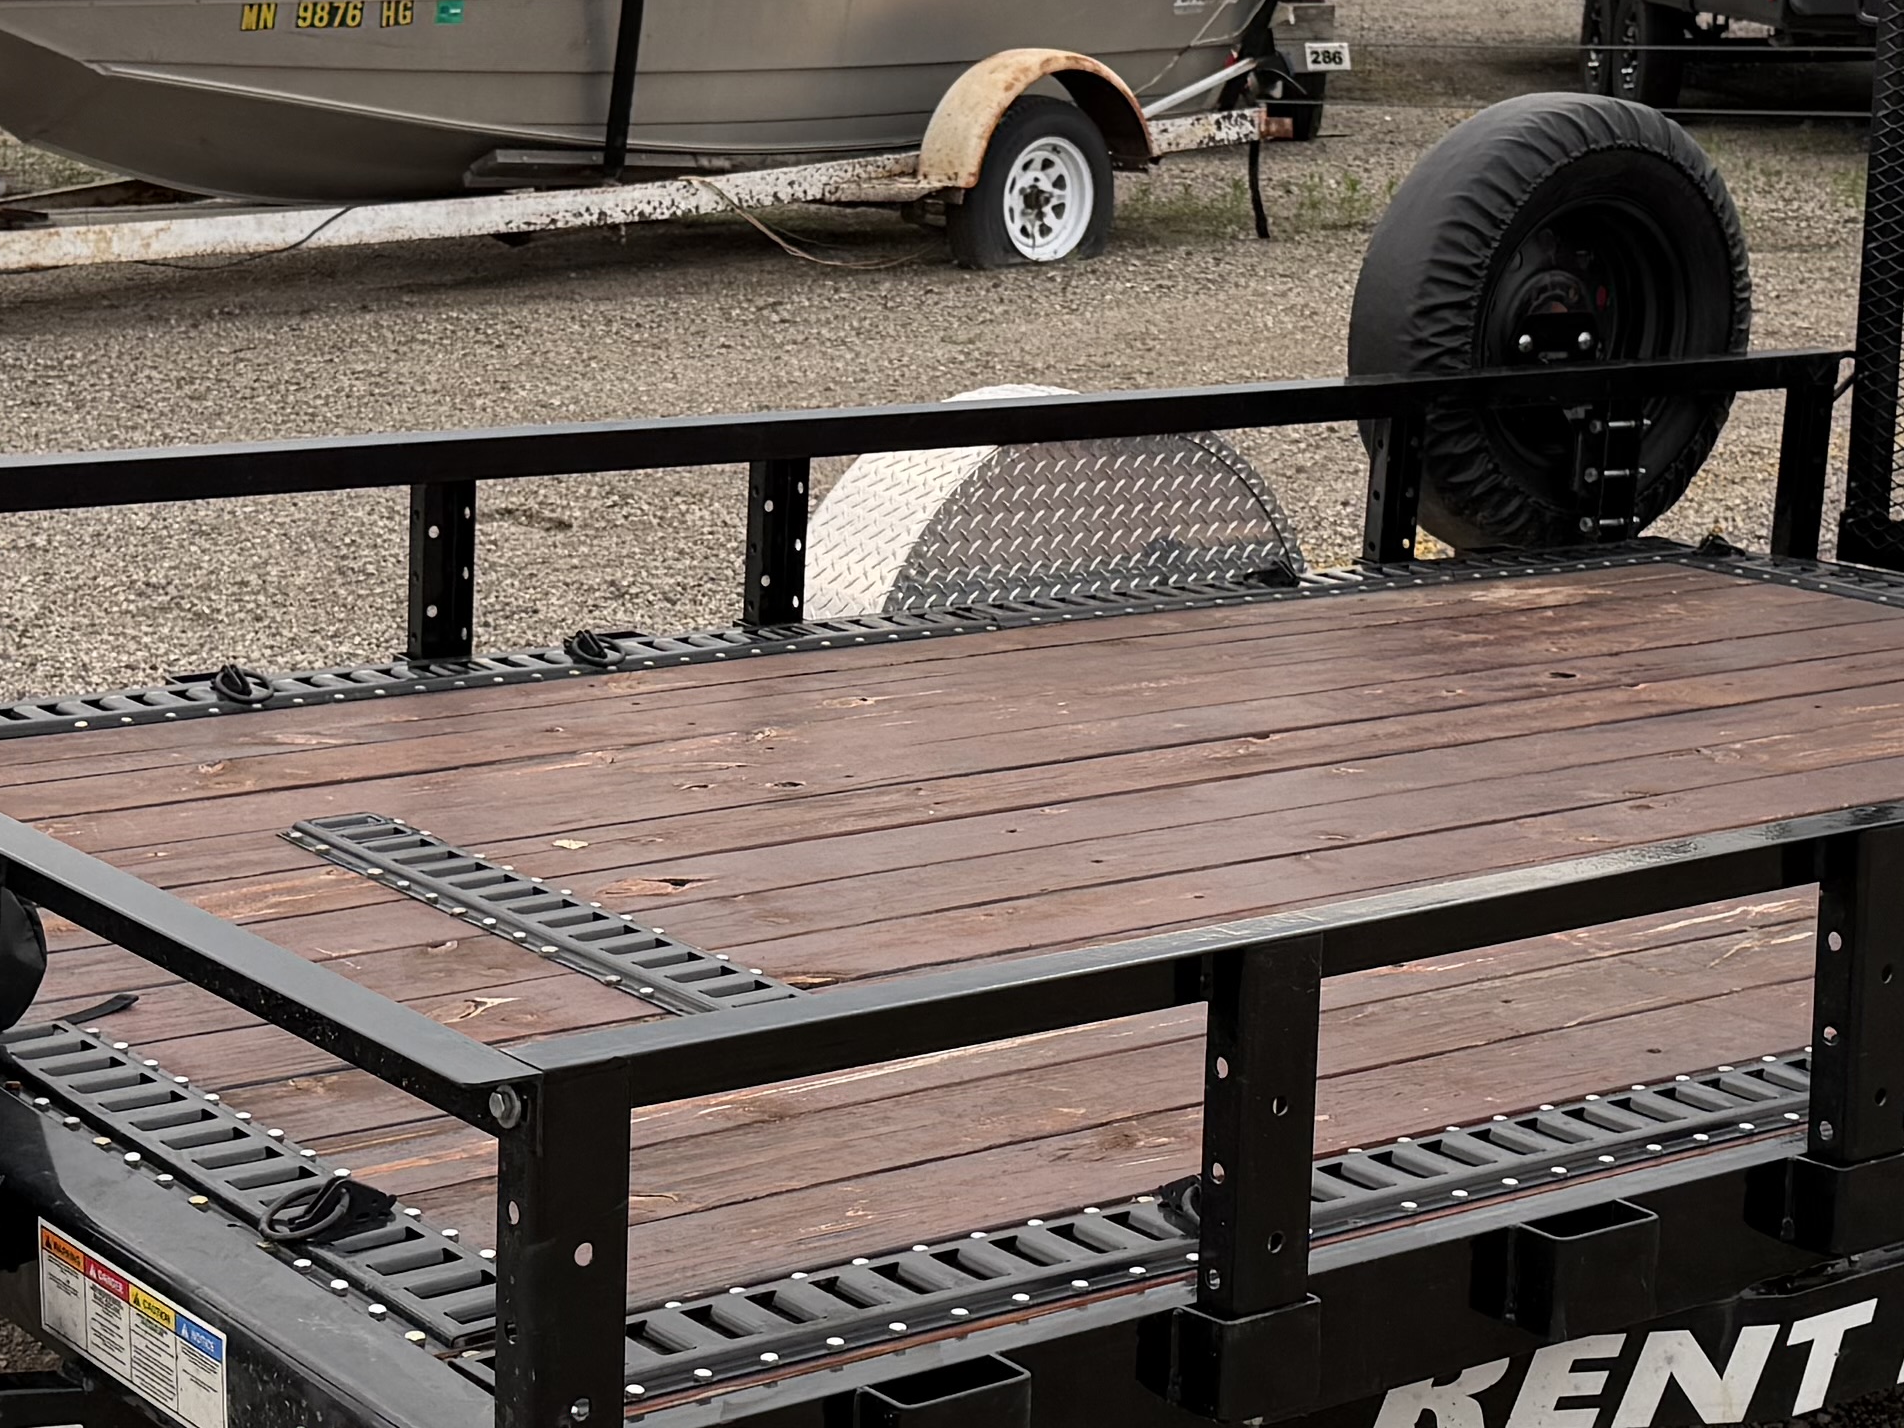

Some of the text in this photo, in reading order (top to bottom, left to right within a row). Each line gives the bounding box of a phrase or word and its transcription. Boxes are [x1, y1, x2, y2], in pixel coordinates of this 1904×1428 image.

[241, 0, 414, 31] MN 9876 HG
[1310, 50, 1343, 65] 286
[141, 1298, 171, 1325] CAUTION
